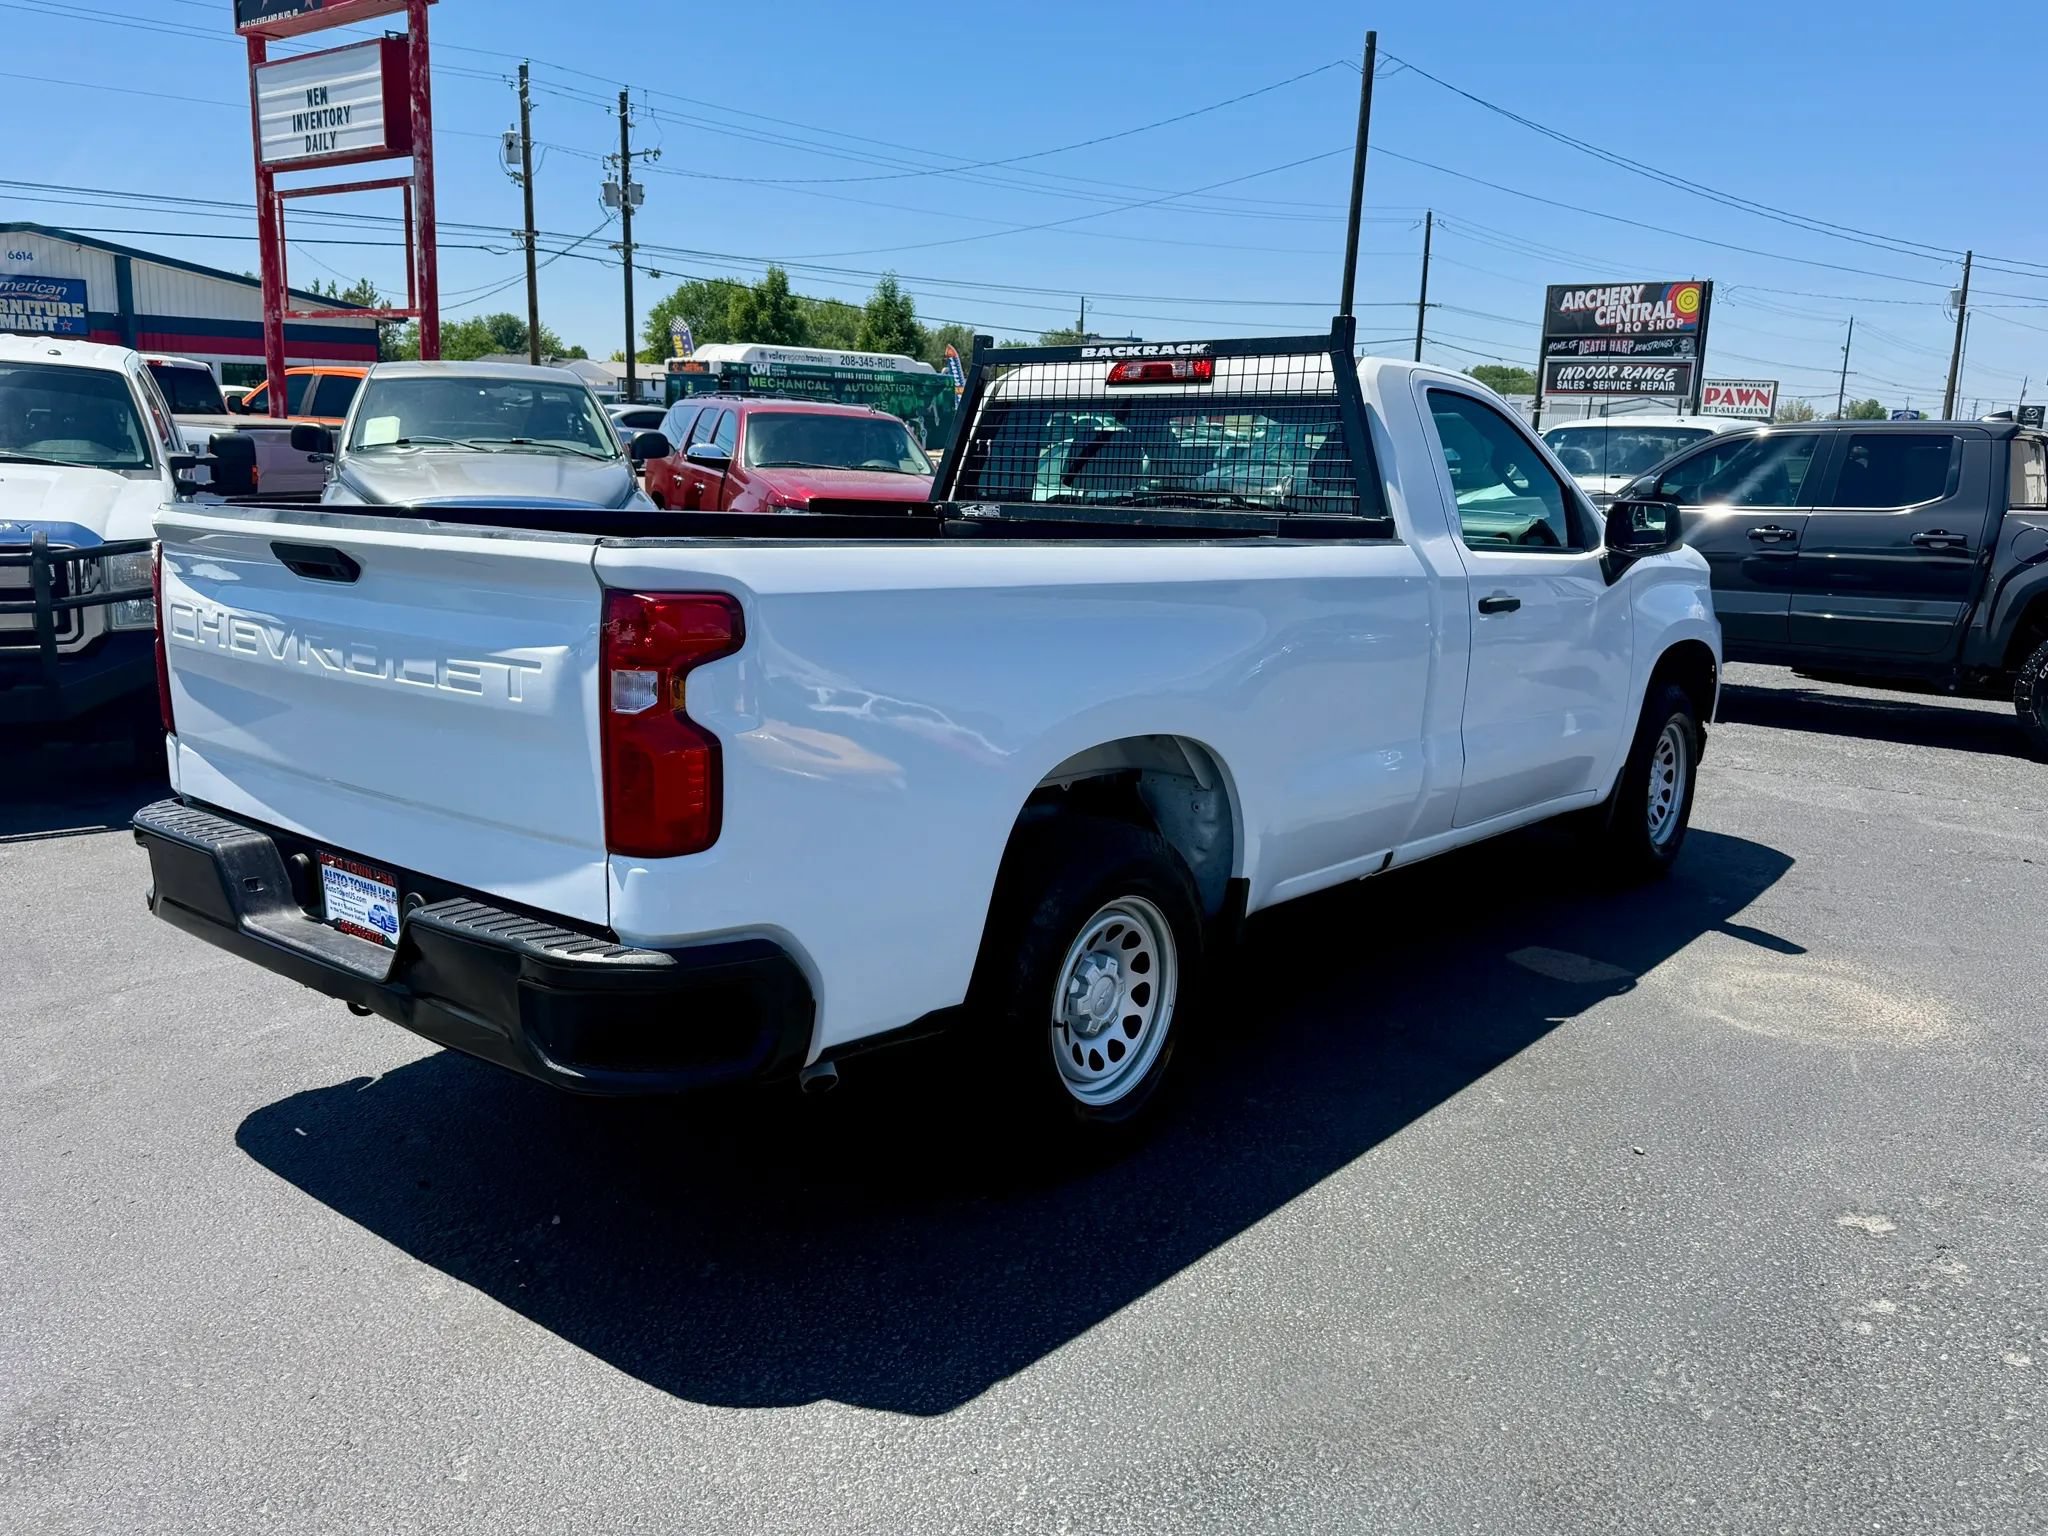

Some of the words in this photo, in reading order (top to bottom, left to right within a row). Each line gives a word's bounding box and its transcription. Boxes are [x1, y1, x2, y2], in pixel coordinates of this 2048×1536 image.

[251, 13, 278, 26] CLEVELAND
[306, 86, 328, 108] NEW
[293, 105, 351, 133] INVENTORY
[305, 131, 337, 153] DAILY
[8, 251, 34, 261] 6614
[1560, 285, 1646, 312] ARCHERY
[1594, 300, 1676, 326] CENTRAL
[0, 313, 58, 331] MART
[1615, 323, 1641, 334] PRO
[1648, 318, 1684, 331] SHOP
[1081, 343, 1208, 358] BACKRACK
[1548, 341, 1569, 353] HOME
[1568, 340, 1579, 350] OF
[1578, 339, 1607, 355] DEATH
[1609, 339, 1635, 355] HARP
[840, 355, 896, 369] 208-345-RIDE
[1557, 365, 1619, 380] INDOOR
[1620, 366, 1678, 381] RANGE
[748, 377, 830, 391] MECHANICAL
[844, 382, 914, 393] AUTOMATION
[1556, 380, 1585, 390] SALES
[1592, 381, 1632, 391] SERVICE
[1640, 381, 1676, 391] REPAIR
[1703, 388, 1771, 407] PAWN
[170, 603, 542, 702] CHEVROLET
[325, 869, 348, 889] AUTO
[348, 877, 378, 898] TOWN
[378, 886, 397, 904] USA
